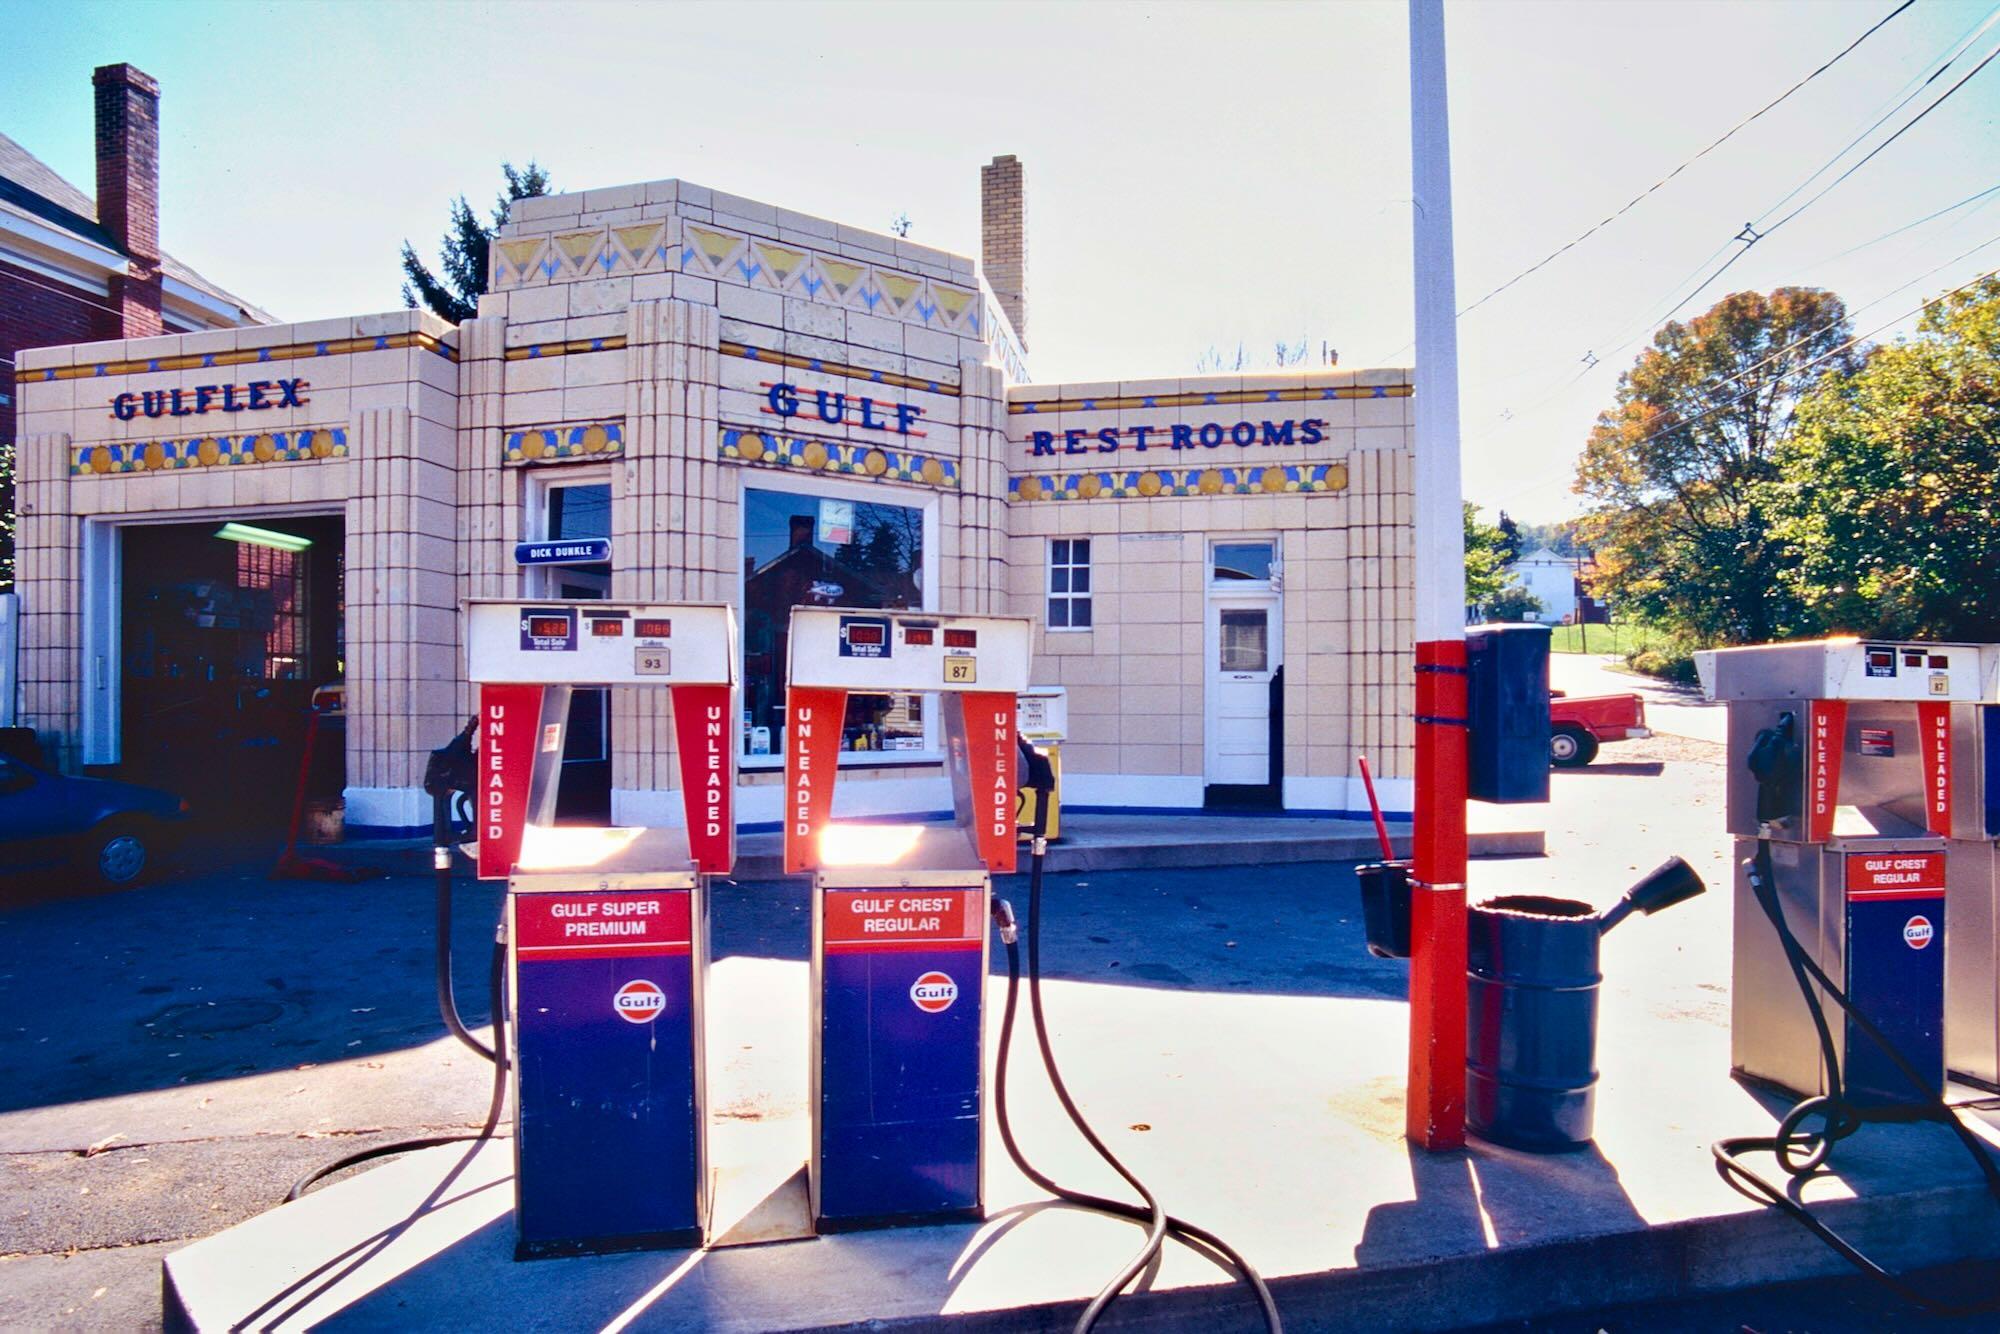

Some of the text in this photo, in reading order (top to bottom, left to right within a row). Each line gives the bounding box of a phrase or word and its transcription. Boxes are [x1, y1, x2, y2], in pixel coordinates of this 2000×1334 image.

[113, 378, 303, 421] GULFLEX
[768, 383, 921, 434] GULF
[1032, 419, 1323, 456] REST ROOMS
[530, 546, 592, 558] DICK DUNKLE
[644, 659, 661, 669] 93
[952, 666, 968, 678] 87
[489, 705, 505, 839] UNLEADED
[707, 706, 721, 836] UNLEADED
[797, 708, 812, 836] UNLEADED
[1816, 716, 1827, 814] UNLEADED
[1936, 716, 1946, 813] UNLEADED
[994, 713, 1007, 836] UNLEADED
[1865, 859, 1928, 871] GULF CREST
[1873, 873, 1921, 884] REGULAR
[551, 901, 660, 917] GULF SUPER
[851, 898, 953, 913] GULF CREST
[565, 921, 646, 936] PREMIUM
[863, 918, 940, 932] REGULAR
[1906, 928, 1930, 938] Gulf
[914, 986, 953, 998] Gulf
[618, 995, 661, 1007] Gulf
